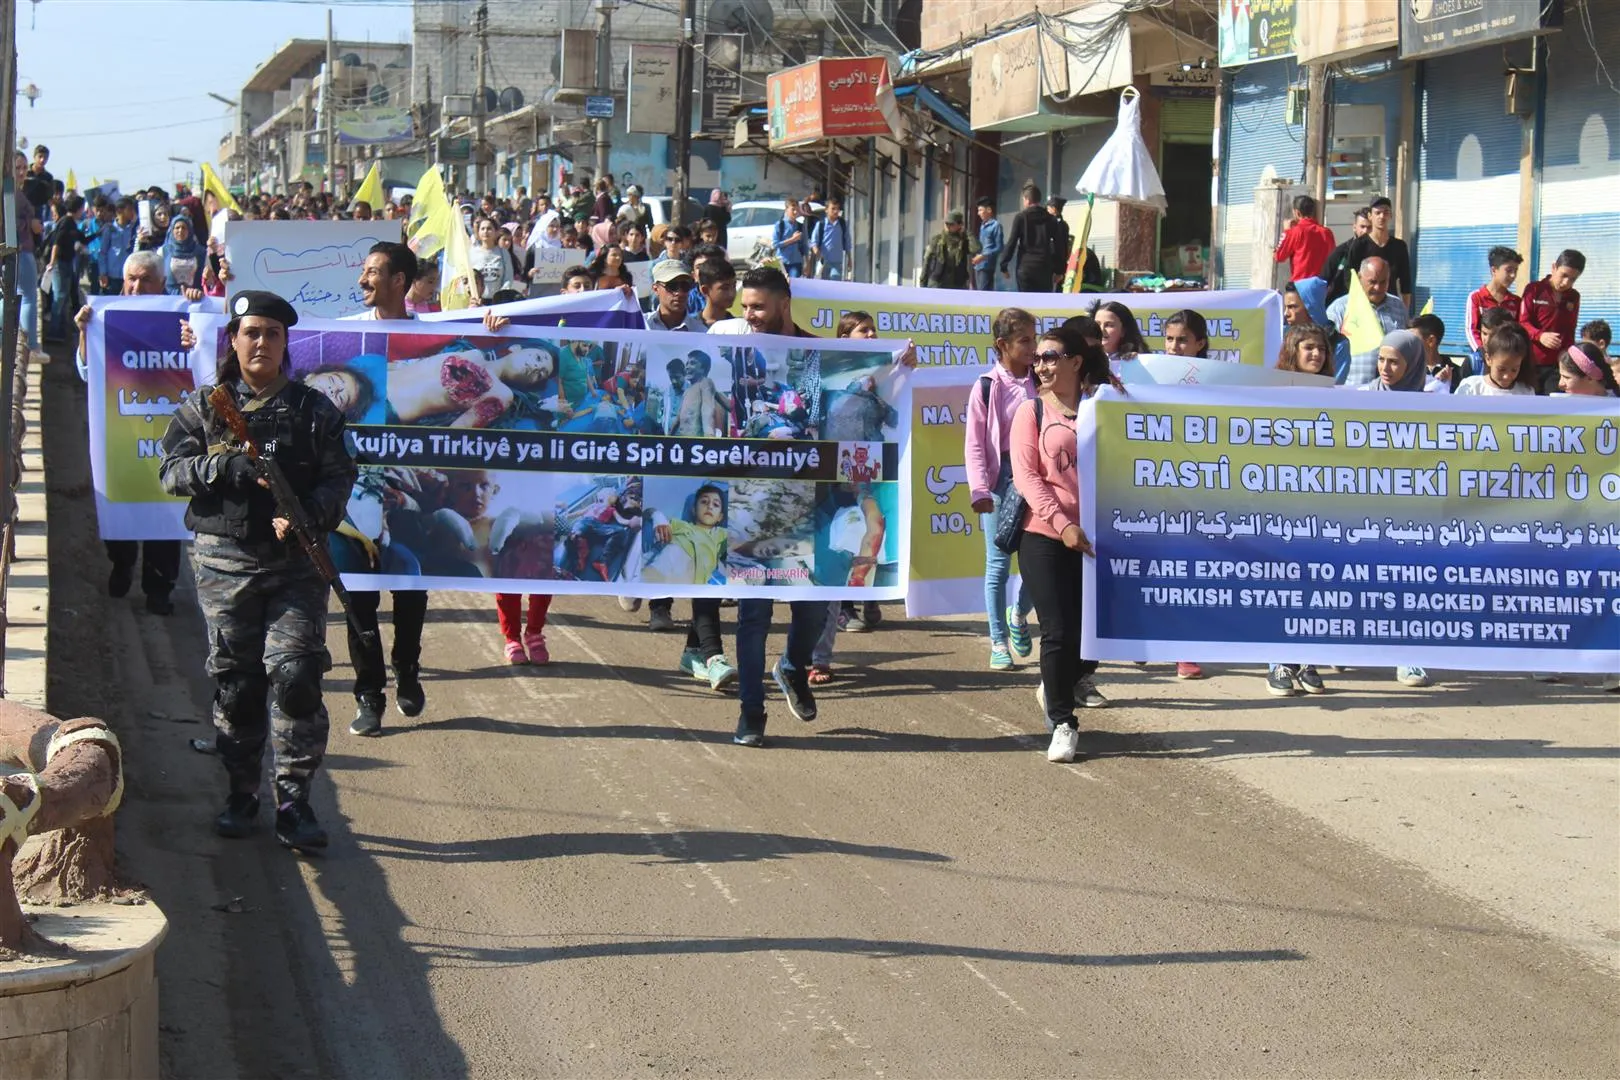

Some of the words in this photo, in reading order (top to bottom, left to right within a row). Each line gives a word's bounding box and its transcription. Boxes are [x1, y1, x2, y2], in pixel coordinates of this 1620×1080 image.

[811, 308, 833, 328] JI
[877, 311, 991, 334] BIKARIBIN
[922, 405, 953, 425] NA
[1125, 413, 1173, 442] EM
[1184, 415, 1217, 444] BI
[1229, 411, 1335, 447] DESTÊ
[1345, 421, 1499, 452] DEWLETA
[1508, 425, 1585, 454] TIRK
[1595, 418, 1618, 455] Û
[430, 435, 511, 461] Tirkiyê
[517, 444, 543, 462] ya
[550, 439, 564, 459] li
[571, 440, 619, 461] Girê
[626, 443, 663, 467] Spî
[671, 443, 685, 464] û
[690, 447, 820, 472] Serêkaniyê
[1134, 455, 1230, 489] RASTÎ
[1240, 460, 1447, 495] QIRKIRINEKÎ
[1459, 463, 1554, 499] FIZÎKÎ
[1566, 465, 1588, 500] Û
[930, 513, 972, 536] NO,
[1112, 508, 1192, 537] الداعشية
[1195, 511, 1261, 539] التركية
[1265, 514, 1317, 543] الدولة
[1321, 521, 1341, 543] يد
[1346, 518, 1381, 543] على
[1385, 518, 1434, 546] دينية
[1439, 519, 1486, 547] ذرائع
[1490, 522, 1530, 544] تحت
[1535, 521, 1584, 549] عرقية
[1110, 558, 1140, 576] WE
[1147, 559, 1187, 577] ARE
[1195, 560, 1300, 579] EXPOSING
[1308, 563, 1334, 580] TO
[1342, 564, 1369, 581] AN
[1377, 564, 1437, 583] ETHIC
[1444, 566, 1559, 585] CLEANSING
[1566, 570, 1592, 587] BY
[1141, 587, 1232, 606] TURKISH
[1239, 589, 1303, 607] STATE
[1309, 591, 1353, 608] AND
[1360, 592, 1396, 609] IT'S
[1403, 593, 1485, 611] BACKED
[1492, 595, 1605, 615] EXTREMIST
[1284, 617, 1356, 636] UNDER
[1363, 619, 1473, 639] RELIGIOUS
[1481, 622, 1570, 641] PRETEXT
